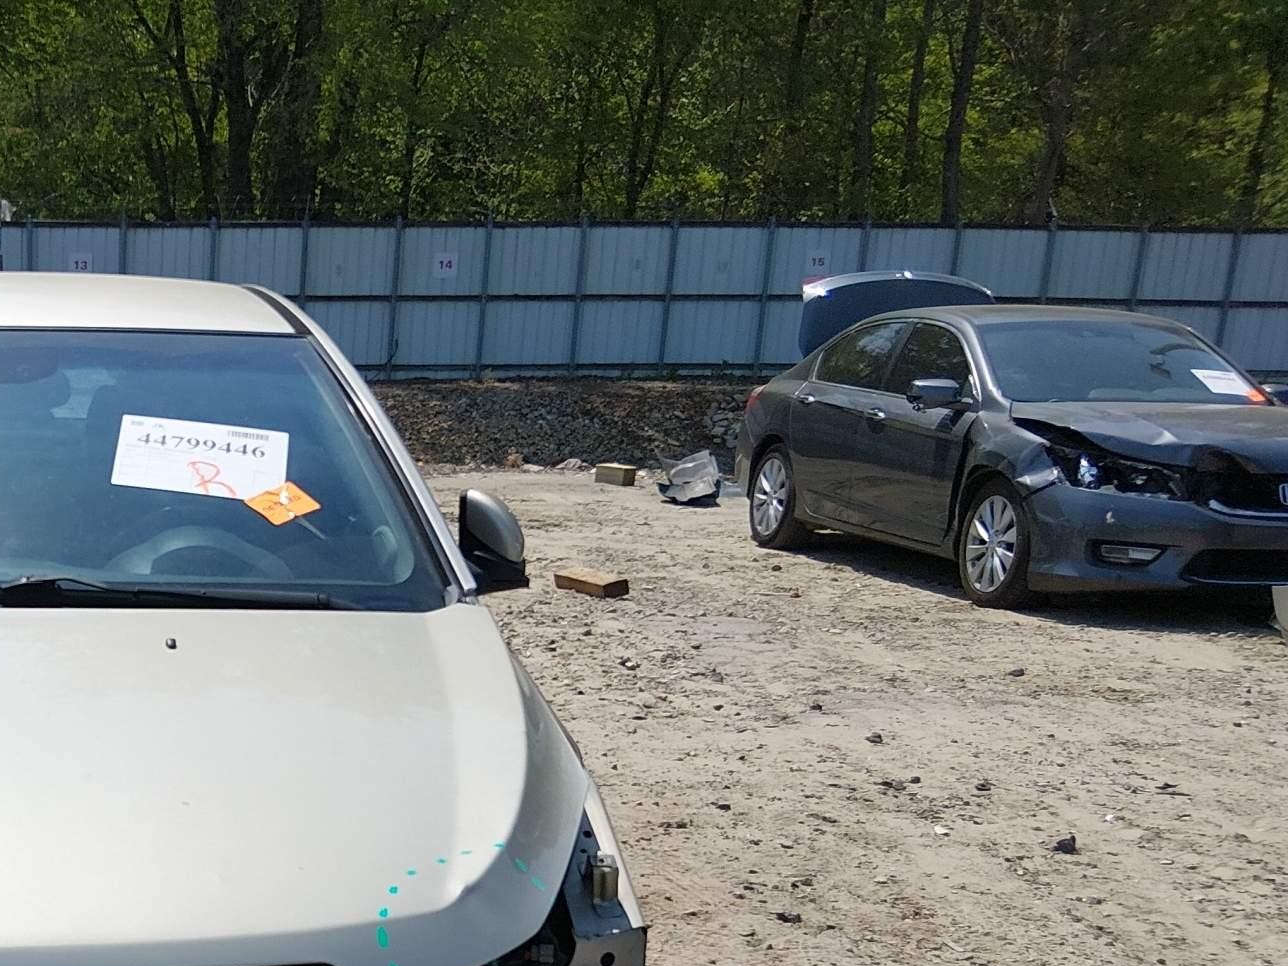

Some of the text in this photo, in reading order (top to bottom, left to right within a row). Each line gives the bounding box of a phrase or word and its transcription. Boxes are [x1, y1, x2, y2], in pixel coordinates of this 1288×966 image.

[73, 260, 88, 271] 13
[438, 260, 453, 270] 14
[811, 257, 825, 267] 15
[136, 432, 266, 459] 44799446
